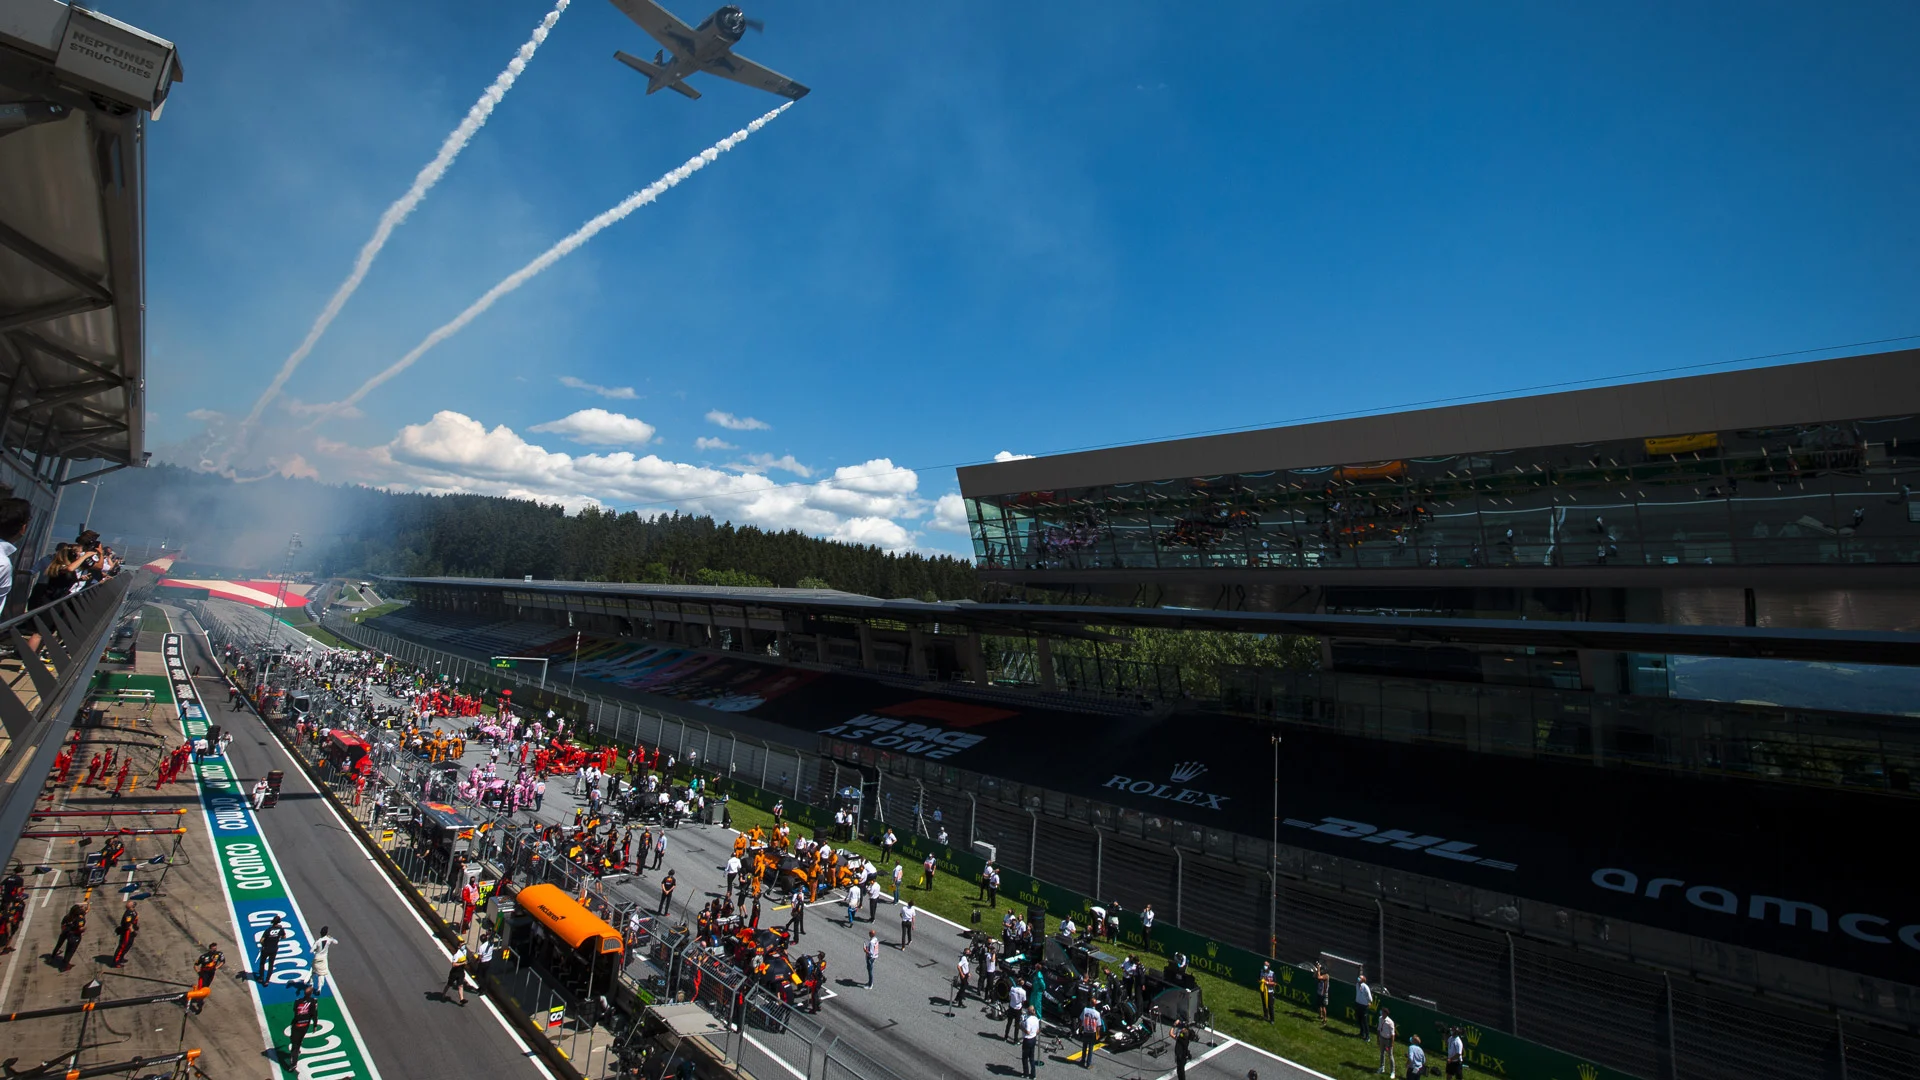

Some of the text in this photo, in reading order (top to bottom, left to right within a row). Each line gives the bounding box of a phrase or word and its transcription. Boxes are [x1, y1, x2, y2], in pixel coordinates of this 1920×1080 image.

[69, 42, 151, 79] STRUCTURES
[72, 31, 155, 70] NEPTUNUS
[844, 714, 988, 749] WE RACE
[871, 735, 961, 759] ONE
[1102, 775, 1230, 811] ROLEX
[211, 797, 249, 830] aramco
[1311, 817, 1482, 863] DHL
[225, 843, 273, 889] aramco
[936, 858, 961, 874] ROLEX
[537, 904, 559, 922] McLaren
[1019, 891, 1049, 909] ROLEX
[1190, 954, 1232, 978] ROLEX
[1273, 983, 1311, 1005] OLEX
